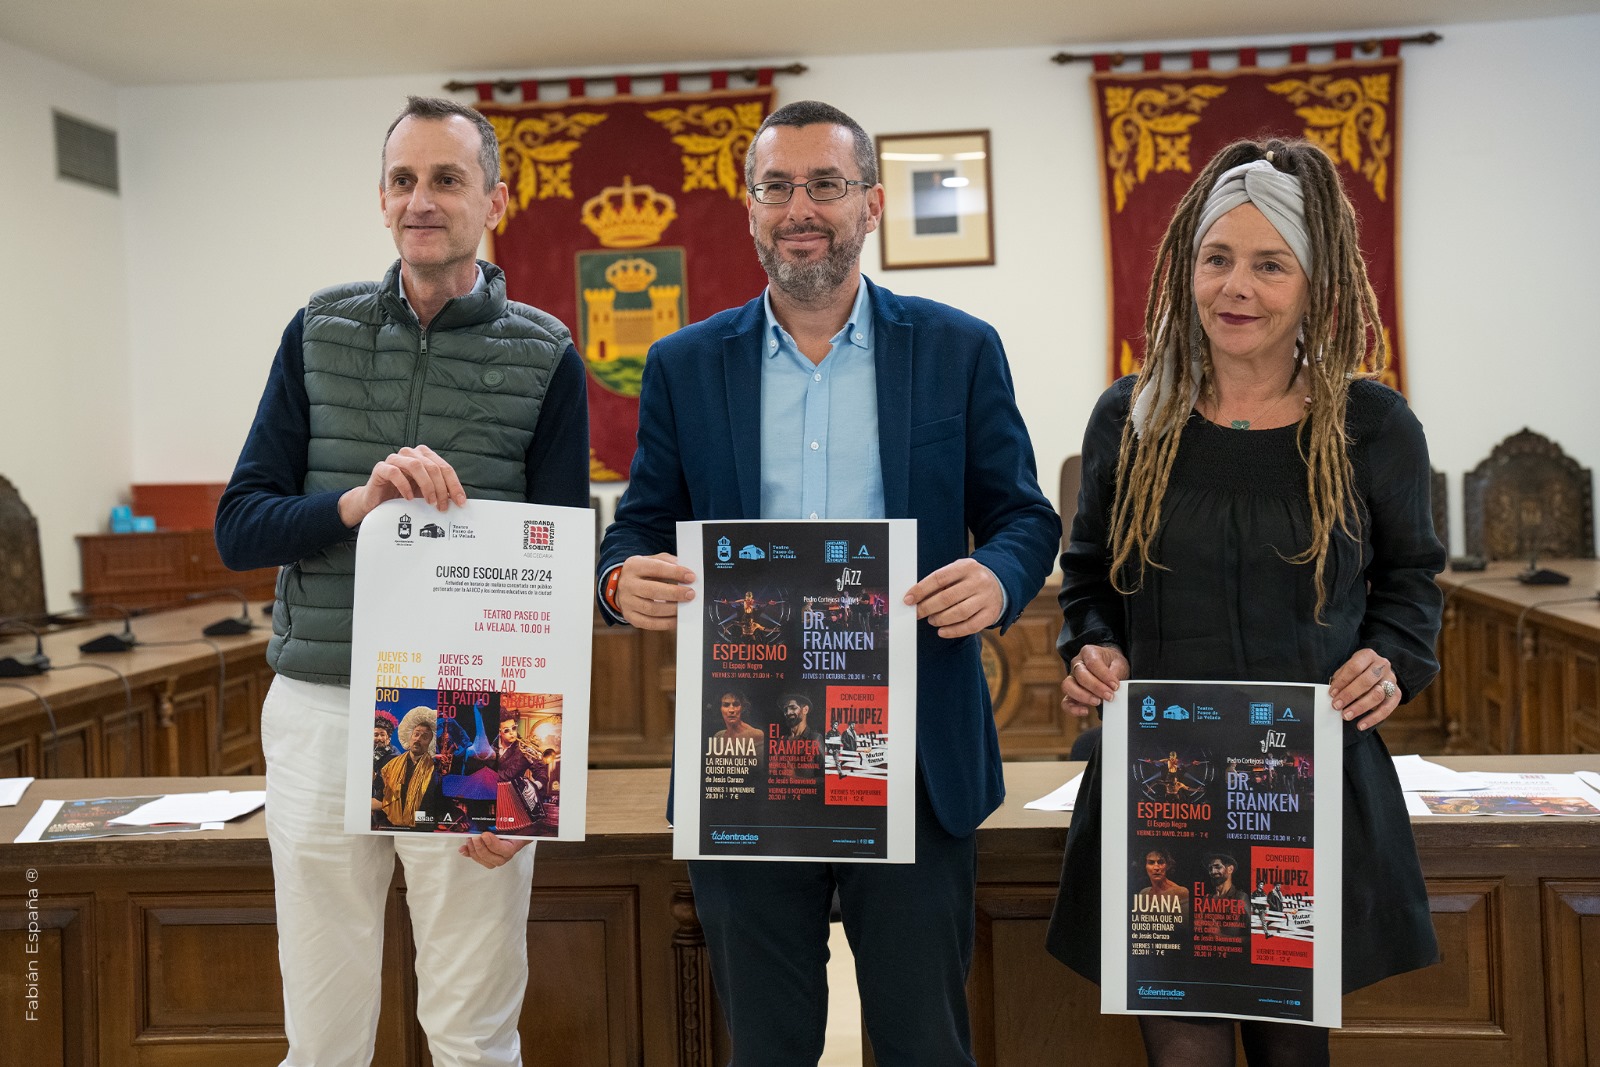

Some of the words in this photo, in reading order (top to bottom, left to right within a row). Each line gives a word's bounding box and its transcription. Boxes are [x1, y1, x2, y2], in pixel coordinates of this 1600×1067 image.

[436, 565, 470, 578] CURSO
[473, 566, 518, 580] ESCOLAR
[521, 568, 552, 582] 23/24
[483, 609, 512, 620] TEATRO
[514, 610, 539, 621] PASEO
[541, 611, 551, 621] DE
[804, 611, 830, 630] DR.
[474, 622, 484, 632] LA
[486, 622, 518, 633] VELADA.
[520, 624, 542, 634] 10.00
[544, 625, 550, 634] H
[803, 631, 874, 650] FRANKEN
[377, 651, 408, 662] JUEVES
[411, 652, 422, 663] 18
[438, 654, 470, 665] JUEVES
[472, 655, 483, 666] 25
[713, 644, 787, 661] ESPEJISMO
[501, 656, 533, 668] JUEVES
[534, 657, 546, 668] 30
[729, 662, 746, 670] Espejo
[747, 662, 763, 670] Negro
[803, 651, 846, 670] STEIN
[377, 663, 402, 674] ABRIL
[438, 666, 464, 677] ABRIL
[501, 668, 526, 679] MAYO
[376, 674, 408, 689] ELLAS
[412, 676, 426, 690] DE
[437, 677, 498, 694] ANDERSEN,
[501, 680, 516, 694] AD
[376, 688, 400, 703] ORO
[437, 691, 450, 706] EL
[452, 692, 490, 706] PATITO
[840, 693, 875, 701] CONCIERTO
[437, 706, 457, 719] FEO
[830, 704, 883, 725] ANTÍLOPEZ
[769, 724, 780, 739] El
[706, 737, 757, 757] JUANA
[769, 735, 820, 756] RÁMPER
[705, 758, 714, 766] LA
[715, 758, 733, 766] REINA
[734, 758, 747, 767] QUE
[748, 758, 758, 766] NO
[705, 766, 725, 775] QUISO
[1227, 772, 1253, 791] DR.
[1226, 792, 1299, 812] FRANKEN
[1137, 802, 1211, 820] ESPEJISMO
[1153, 820, 1170, 828] Espejo
[1171, 821, 1187, 829] Negro
[1226, 812, 1271, 832] STEIN
[710, 830, 759, 841] tickentradas
[1265, 854, 1300, 864] CONCIERTO
[1256, 866, 1309, 887] ANTÍLOPEZ
[1194, 881, 1204, 896] El
[1131, 894, 1182, 914] JUANA
[1194, 893, 1246, 914] RÁMPER
[1132, 923, 1151, 931] QUISO
[1152, 923, 1175, 931] REINAR
[1160, 915, 1172, 923] QUE
[1173, 915, 1183, 924] NO
[1137, 986, 1186, 997] tickentradas
